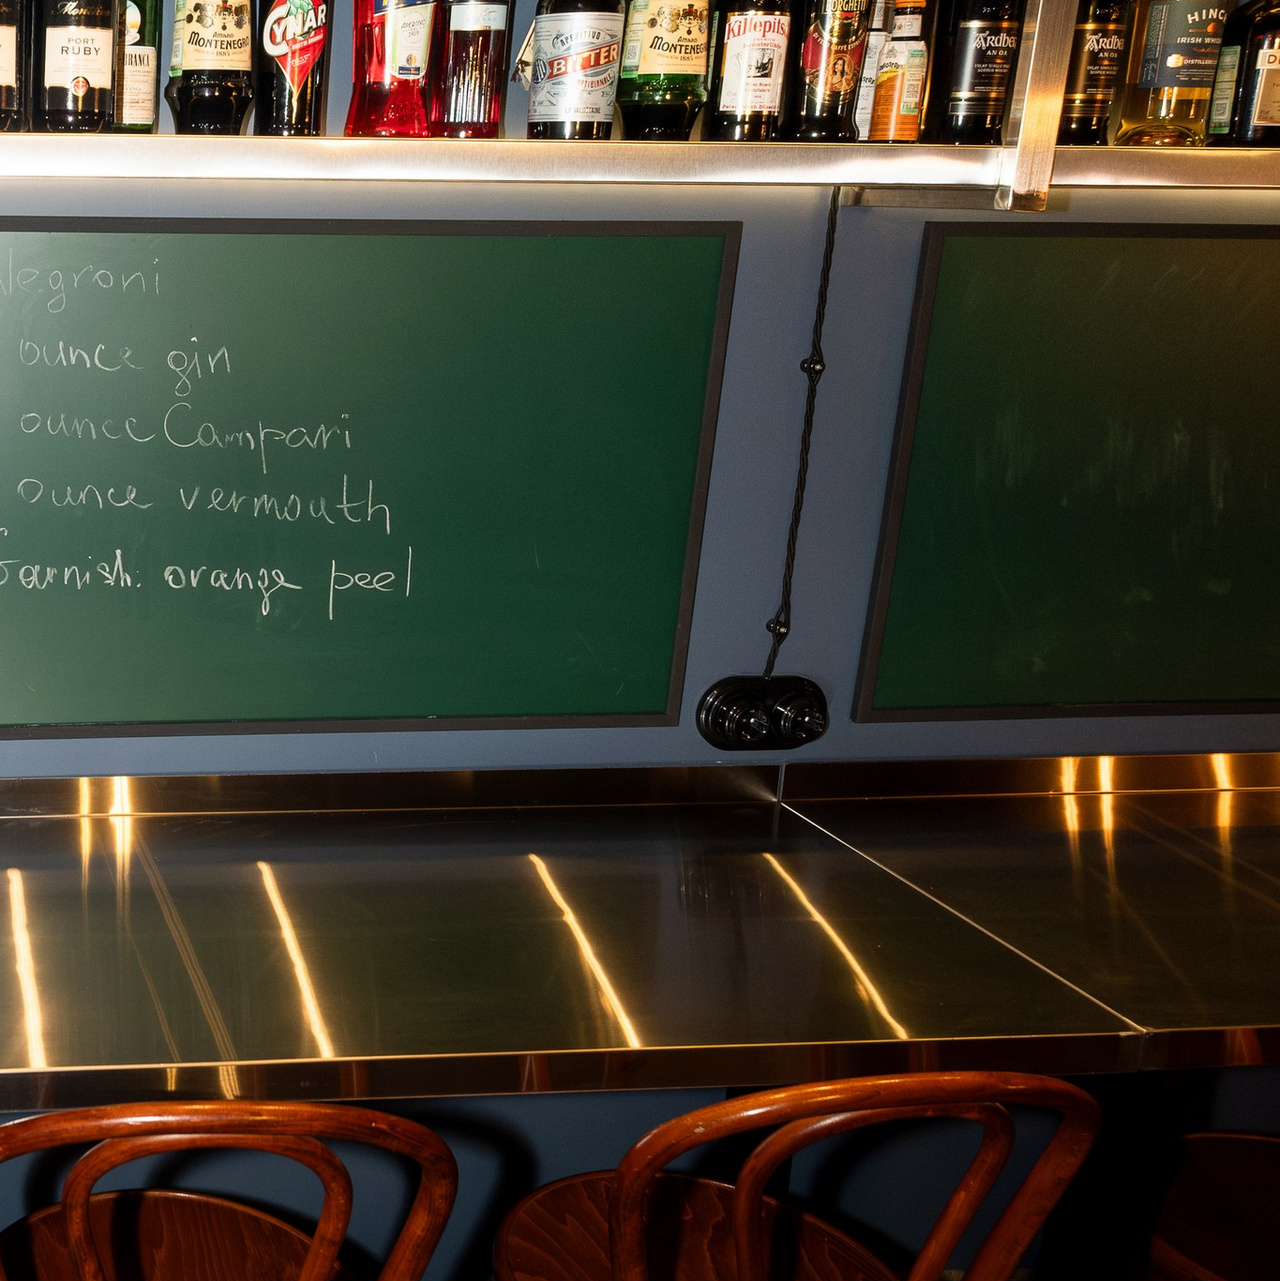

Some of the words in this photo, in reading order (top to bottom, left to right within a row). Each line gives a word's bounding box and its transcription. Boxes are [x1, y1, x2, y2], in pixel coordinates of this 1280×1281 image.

[1186, 7, 1228, 24] HINC
[67, 37, 96, 45] PORT
[187, 30, 250, 51] MONTENEGRO
[263, 3, 327, 57] CYNAR
[1176, 36, 1202, 44] IRISH
[60, 46, 102, 57] RUBY
[552, 44, 619, 76] BITTER
[20, 337, 144, 372] ounce
[166, 335, 231, 397] gin
[17, 477, 153, 509] ounce
[179, 473, 391, 535] vermouth
[164, 563, 304, 616] orange
[328, 546, 413, 620] peel
